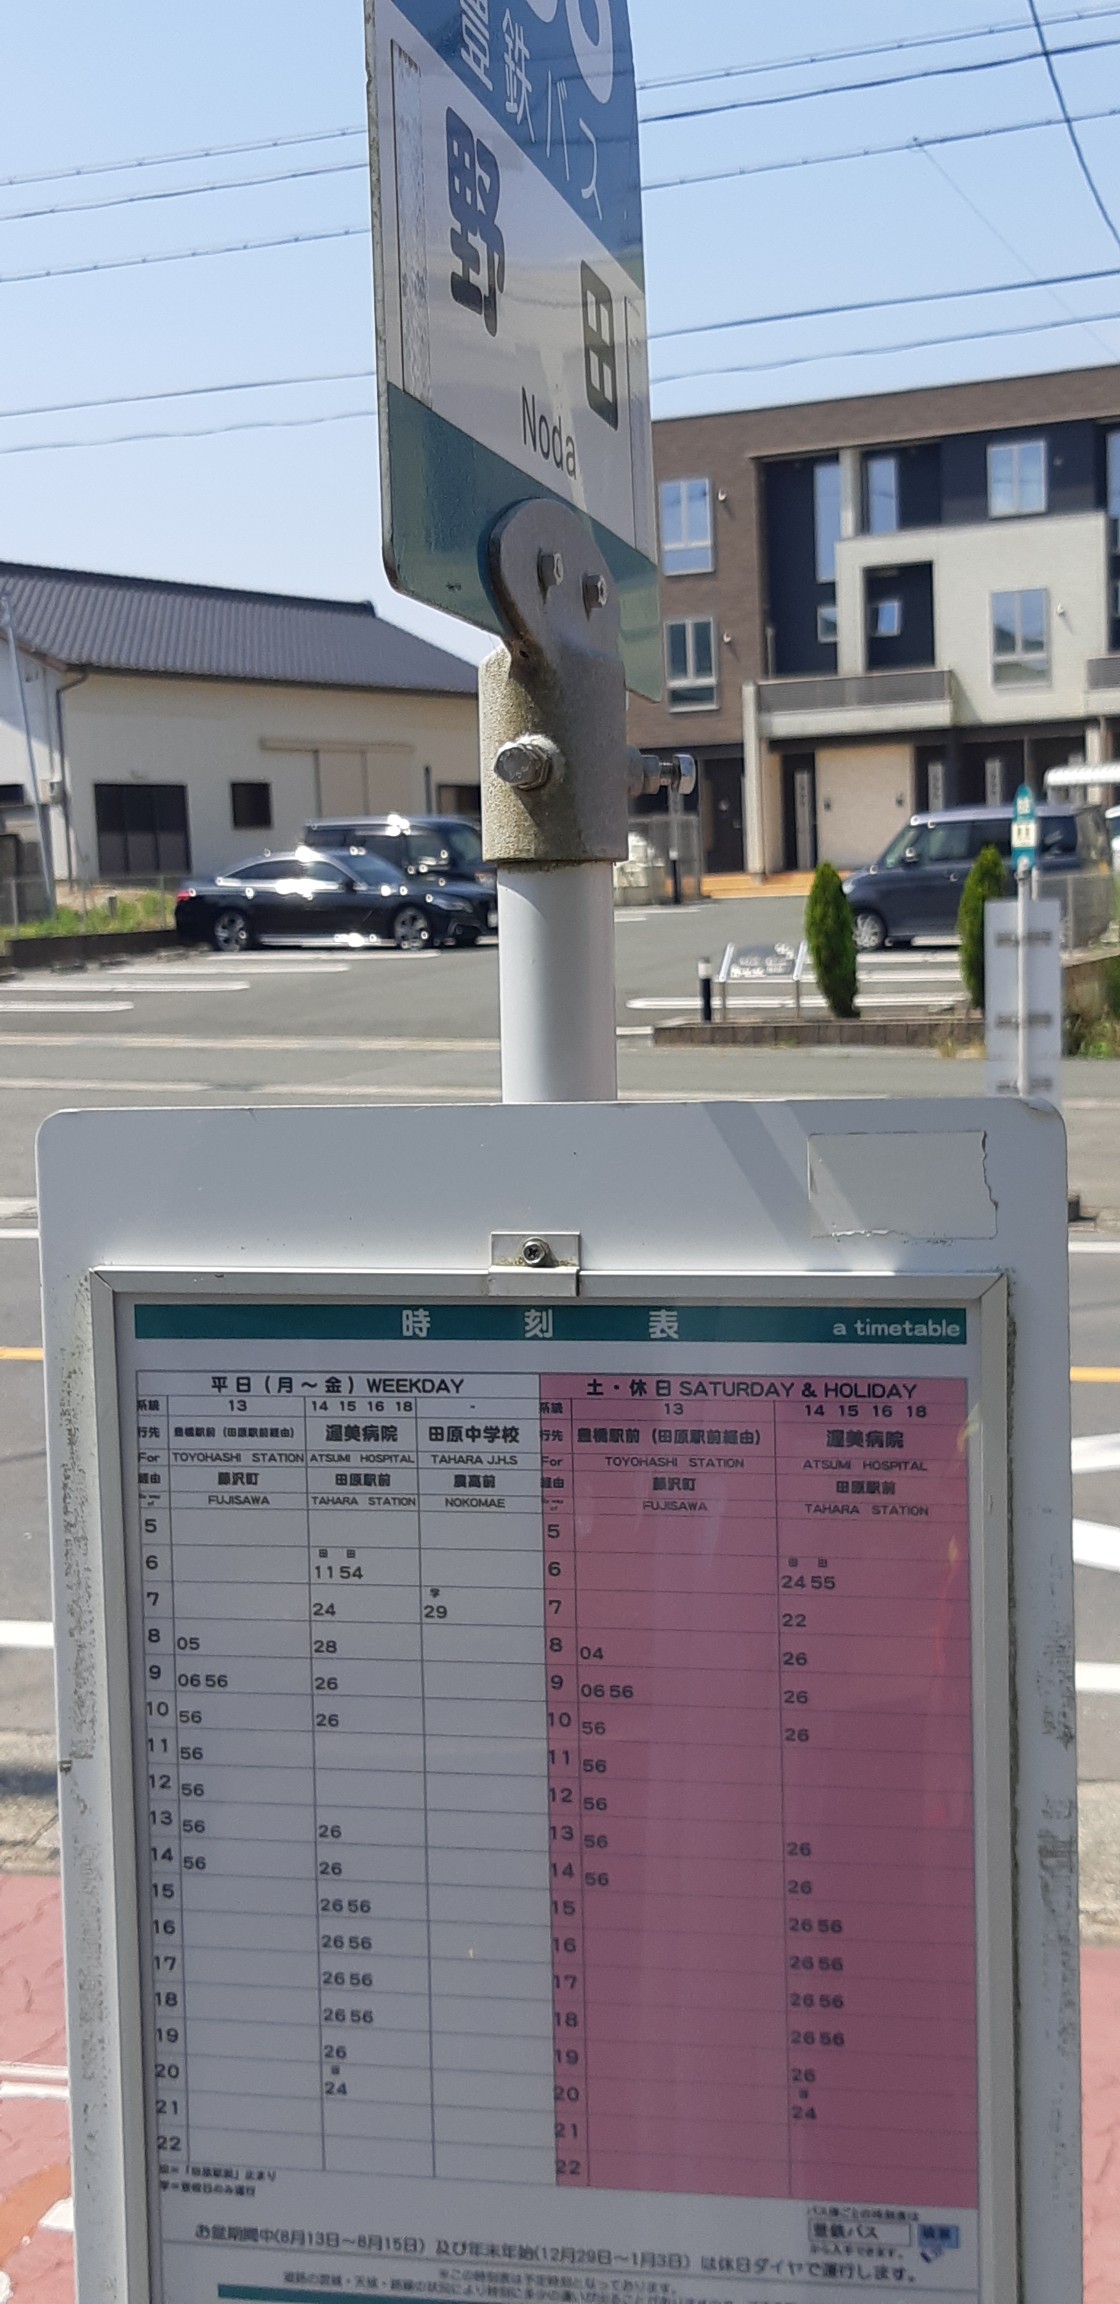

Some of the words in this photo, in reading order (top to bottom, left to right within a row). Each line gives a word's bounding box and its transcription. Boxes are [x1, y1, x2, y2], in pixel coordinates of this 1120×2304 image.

[521, 386, 577, 480] Noda
[401, 1307, 679, 1340] 時刻表
[832, 1322, 847, 1336] a
[854, 1318, 961, 1337] timetable
[366, 1378, 465, 1394] WEEKDAY
[679, 1380, 795, 1397] SATURDAY
[801, 1381, 818, 1398] &
[824, 1382, 918, 1399] HOLIDAY
[227, 1399, 248, 1412] 13
[311, 1400, 329, 1412] 14
[339, 1400, 357, 1412] 15
[367, 1400, 385, 1412] 16
[395, 1400, 413, 1413] 18
[664, 1402, 685, 1416] 13
[804, 1404, 825, 1417] 14
[838, 1404, 859, 1417] 15
[872, 1405, 893, 1418] 16
[906, 1405, 928, 1418] 18
[428, 1425, 520, 1444] 田原中学校
[137, 1451, 161, 1463] For
[171, 1452, 242, 1463] TOYOHASHI
[251, 1452, 305, 1464] STATION
[309, 1452, 351, 1463] ATSUMI
[359, 1453, 415, 1464] HOSPITAL
[431, 1454, 484, 1465] TAHARA
[540, 1456, 563, 1468] For
[604, 1456, 678, 1468] TOYOHASHI
[688, 1457, 745, 1469] STATION
[802, 1459, 851, 1471] ATSUMI
[862, 1460, 928, 1472] HOSPITAL
[207, 1495, 271, 1506] FUJISAWA
[311, 1495, 359, 1506] TAHARA
[367, 1496, 417, 1507] STATION
[445, 1497, 506, 1509] NOKOMAE
[642, 1500, 708, 1512] FUJISAWA
[806, 1503, 860, 1515] TAHARA
[871, 1504, 929, 1516] STATION
[144, 1518, 158, 1534] 5
[547, 1523, 560, 1539] 5
[145, 1554, 159, 1570] 6
[548, 1561, 561, 1577] 6
[314, 1565, 334, 1580] 11
[339, 1565, 364, 1580] 54
[780, 1574, 806, 1590] 24
[810, 1575, 836, 1590] 55
[146, 1591, 160, 1607] 7
[548, 1599, 562, 1615] 7
[312, 1602, 337, 1617] 24
[423, 1604, 448, 1619] 29
[781, 1613, 808, 1628] 22
[147, 1628, 161, 1644] 8
[176, 1636, 200, 1651] 05
[313, 1639, 338, 1654] 28
[549, 1637, 563, 1653] 8
[579, 1646, 604, 1660] 04
[782, 1651, 808, 1667] 26
[148, 1664, 162, 1680] 9
[177, 1673, 201, 1688] 06
[205, 1674, 229, 1688] 56
[314, 1676, 339, 1691] 26
[550, 1674, 564, 1690] 9
[580, 1683, 605, 1698] 06
[609, 1684, 634, 1699] 56
[783, 1689, 809, 1705] 26
[146, 1701, 169, 1717] 10
[178, 1710, 203, 1724] 56
[315, 1713, 340, 1728] 26
[548, 1711, 572, 1728] 10
[581, 1721, 606, 1736] 56
[784, 1727, 810, 1743] 26
[147, 1737, 169, 1753] 11
[179, 1746, 204, 1761] 56
[548, 1749, 570, 1765] 11
[582, 1758, 607, 1774] 56
[148, 1774, 172, 1790] 12
[180, 1783, 205, 1797] 56
[549, 1787, 573, 1803] 12
[583, 1796, 608, 1811] 56
[149, 1810, 173, 1826] 13
[182, 1819, 206, 1834] 56
[317, 1824, 342, 1839] 26
[549, 1825, 574, 1841] 13
[583, 1834, 609, 1849] 56
[785, 1842, 813, 1857] 26
[150, 1847, 174, 1862] 14
[183, 1855, 207, 1871] 56
[318, 1861, 343, 1876] 26
[550, 1862, 575, 1879] 14
[584, 1871, 610, 1887] 56
[786, 1879, 813, 1895] 26
[151, 1882, 175, 1899] 15
[319, 1898, 344, 1913] 26
[347, 1899, 372, 1914] 56
[551, 1900, 576, 1916] 15
[152, 1919, 176, 1935] 16
[787, 1917, 813, 1933] 26
[816, 1918, 844, 1934] 56
[321, 1934, 345, 1950] 26
[348, 1935, 373, 1950] 56
[552, 1937, 577, 1953] 16
[153, 1955, 177, 1971] 17
[788, 1955, 814, 1971] 26
[817, 1956, 844, 1972] 56
[321, 1971, 346, 1986] 26
[349, 1972, 374, 1987] 56
[553, 1974, 578, 1990] 17
[154, 1991, 179, 2007] 18
[789, 1993, 815, 2008] 26
[818, 1994, 845, 2009] 56
[322, 2007, 347, 2023] 26
[349, 2009, 374, 2024] 56
[553, 2011, 579, 2028] 18
[154, 2027, 180, 2043] 19
[790, 2030, 816, 2046] 26
[819, 2032, 846, 2047] 56
[323, 2044, 348, 2059] 26
[554, 2048, 580, 2065] 19
[154, 2063, 180, 2079] 20
[791, 2068, 817, 2084] 26
[324, 2081, 348, 2096] 24
[553, 2085, 580, 2102] 20
[155, 2099, 179, 2116] 21
[791, 2105, 817, 2121] 24
[554, 2122, 579, 2139] 21
[156, 2135, 182, 2151] 22
[555, 2159, 582, 2176] 22
